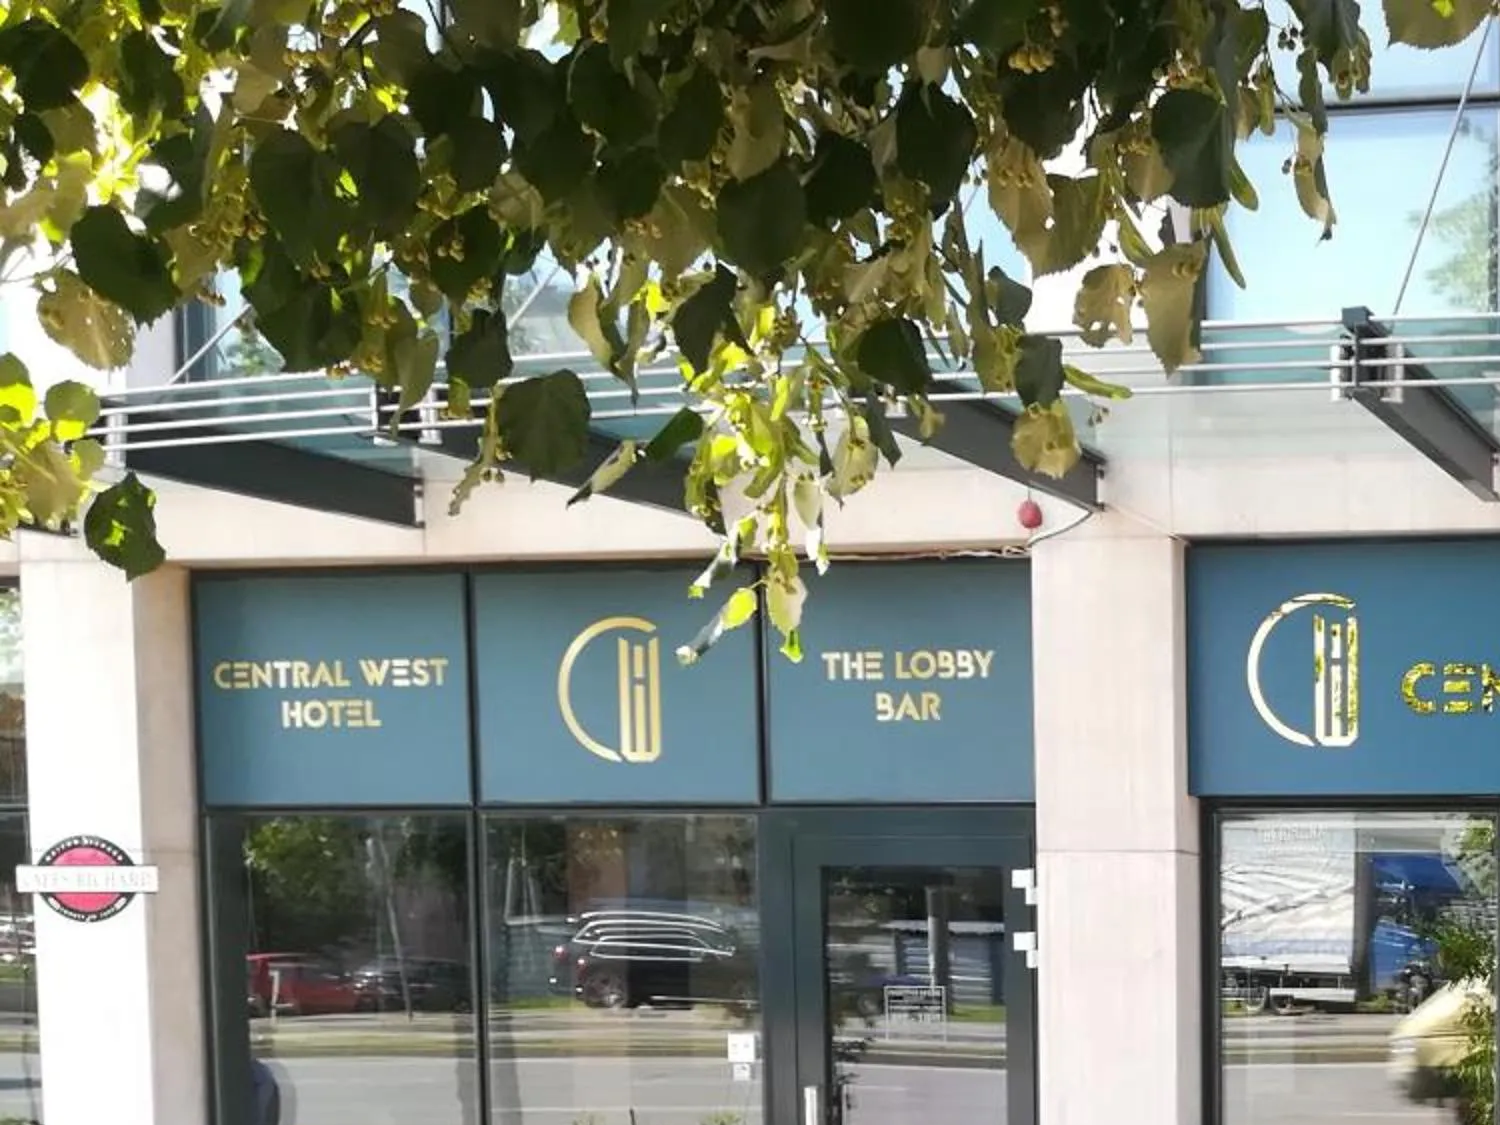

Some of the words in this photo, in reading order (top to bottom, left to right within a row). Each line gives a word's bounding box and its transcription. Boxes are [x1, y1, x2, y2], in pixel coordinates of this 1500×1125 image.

[213, 659, 350, 690] CENTRAL
[360, 658, 449, 687] WEST
[821, 651, 884, 682] THE
[895, 649, 995, 680] LOBBY
[281, 698, 382, 728] HOTEL
[875, 692, 942, 722] BAR
